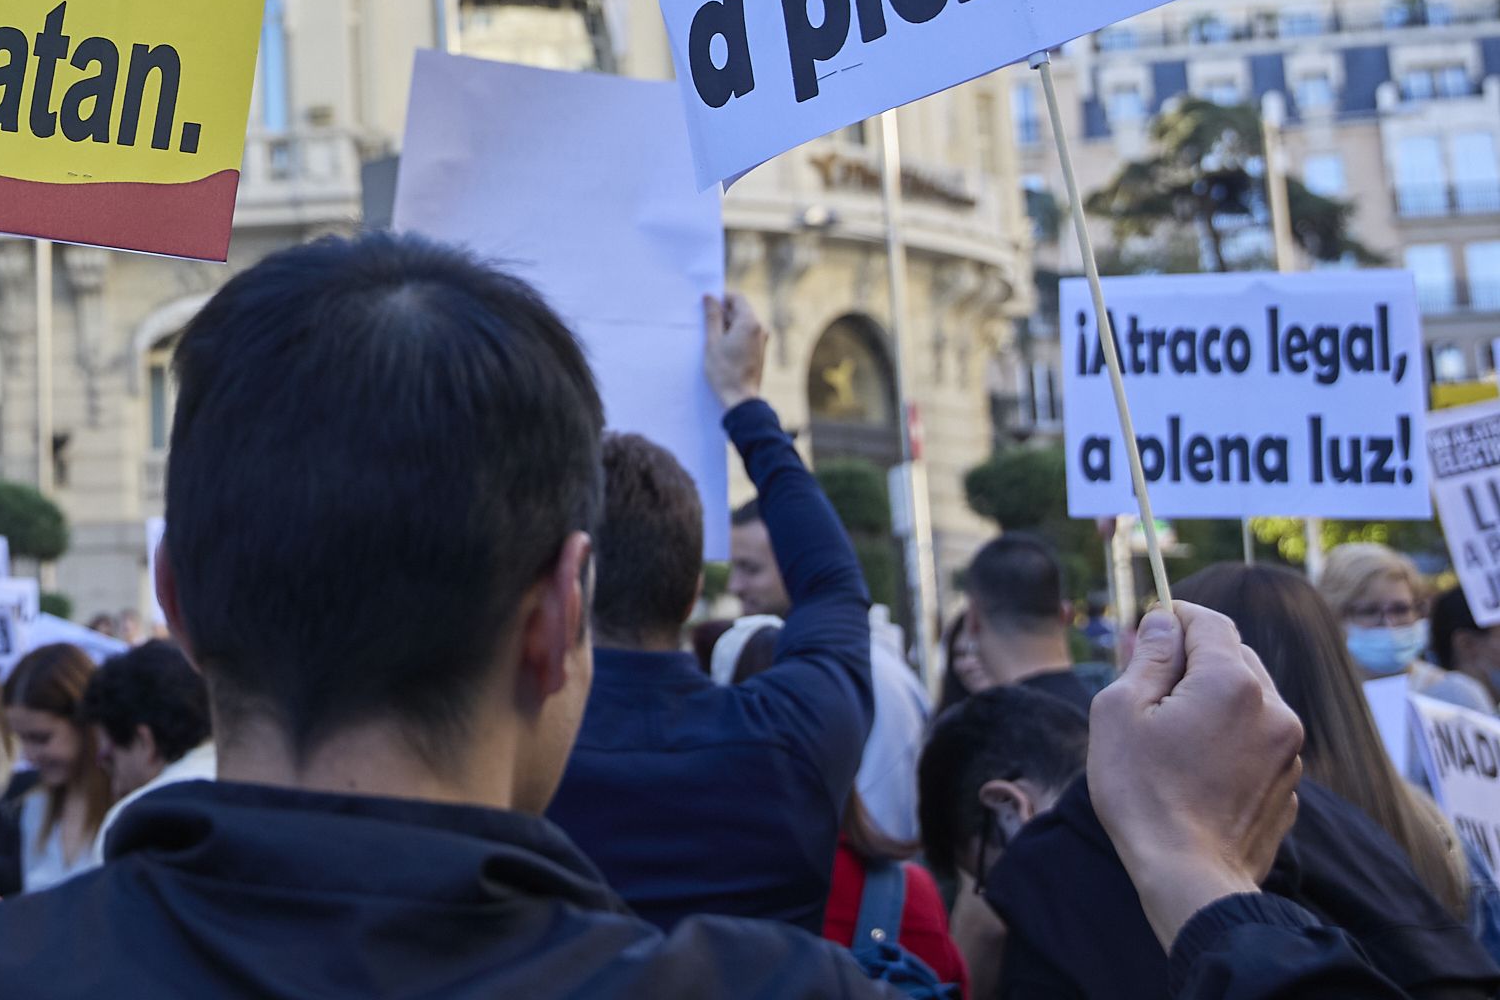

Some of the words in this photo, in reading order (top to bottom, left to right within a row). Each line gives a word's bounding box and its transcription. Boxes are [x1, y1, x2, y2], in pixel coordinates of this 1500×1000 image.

[1075, 308, 1253, 378] ¡Atraco
[1266, 303, 1410, 387] legal,
[1079, 435, 1113, 483] a
[1130, 413, 1290, 497] plena
[1307, 413, 1416, 486] luz!
